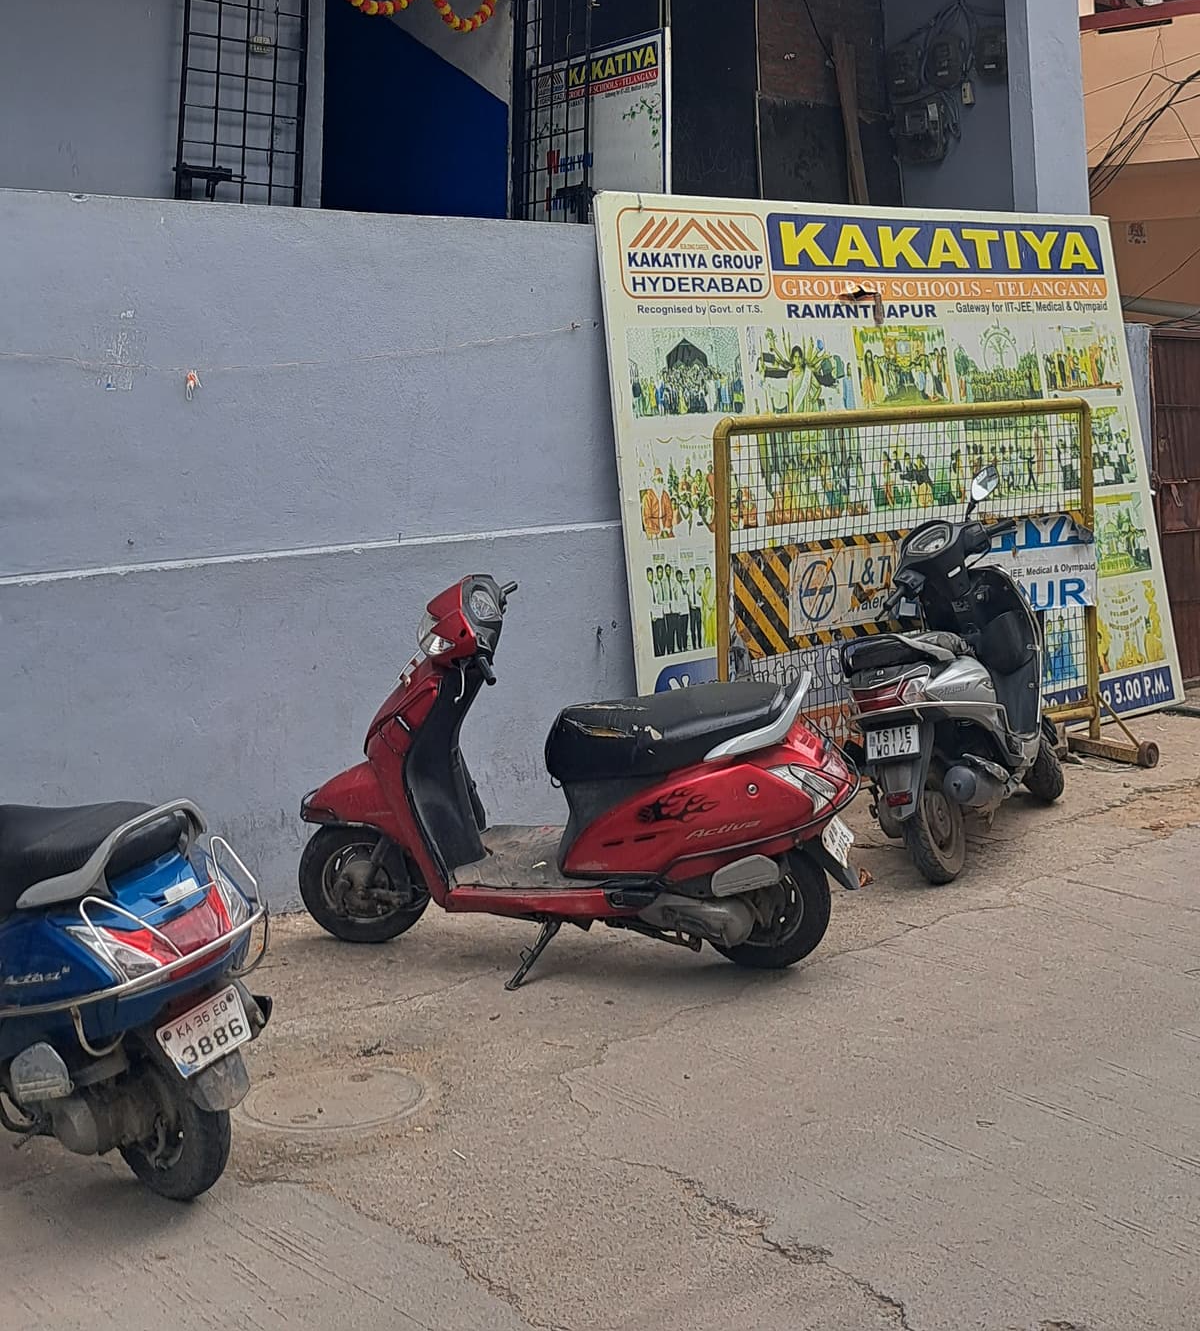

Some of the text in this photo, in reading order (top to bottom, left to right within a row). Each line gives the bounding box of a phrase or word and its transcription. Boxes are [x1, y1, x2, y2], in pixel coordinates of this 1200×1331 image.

[779, 220, 1099, 270] KAKATIYA
[627, 251, 763, 270] KAKATIYA GROUP
[632, 276, 763, 293] HYDERABAD
[891, 281, 982, 298] SCHOOLS
[994, 280, 1104, 298] TELANGANA
[637, 305, 763, 315] Recognised by Govt. of T.S.
[955, 303, 990, 315] Gateway
[991, 302, 1003, 313] for
[1004, 301, 1035, 314] IIT-JEE,
[1035, 301, 1065, 313] Medical
[1066, 301, 1072, 311] &
[1073, 300, 1108, 314] Olympaid
[1026, 566, 1052, 576] Medical
[1114, 679, 1142, 705] 5.00
[1143, 672, 1170, 697] P.M.
[875, 727, 912, 743] TS11E
[686, 819, 762, 840] Activa
[175, 1001, 229, 1039] KA 36 EQ
[181, 1017, 244, 1065] 3886
